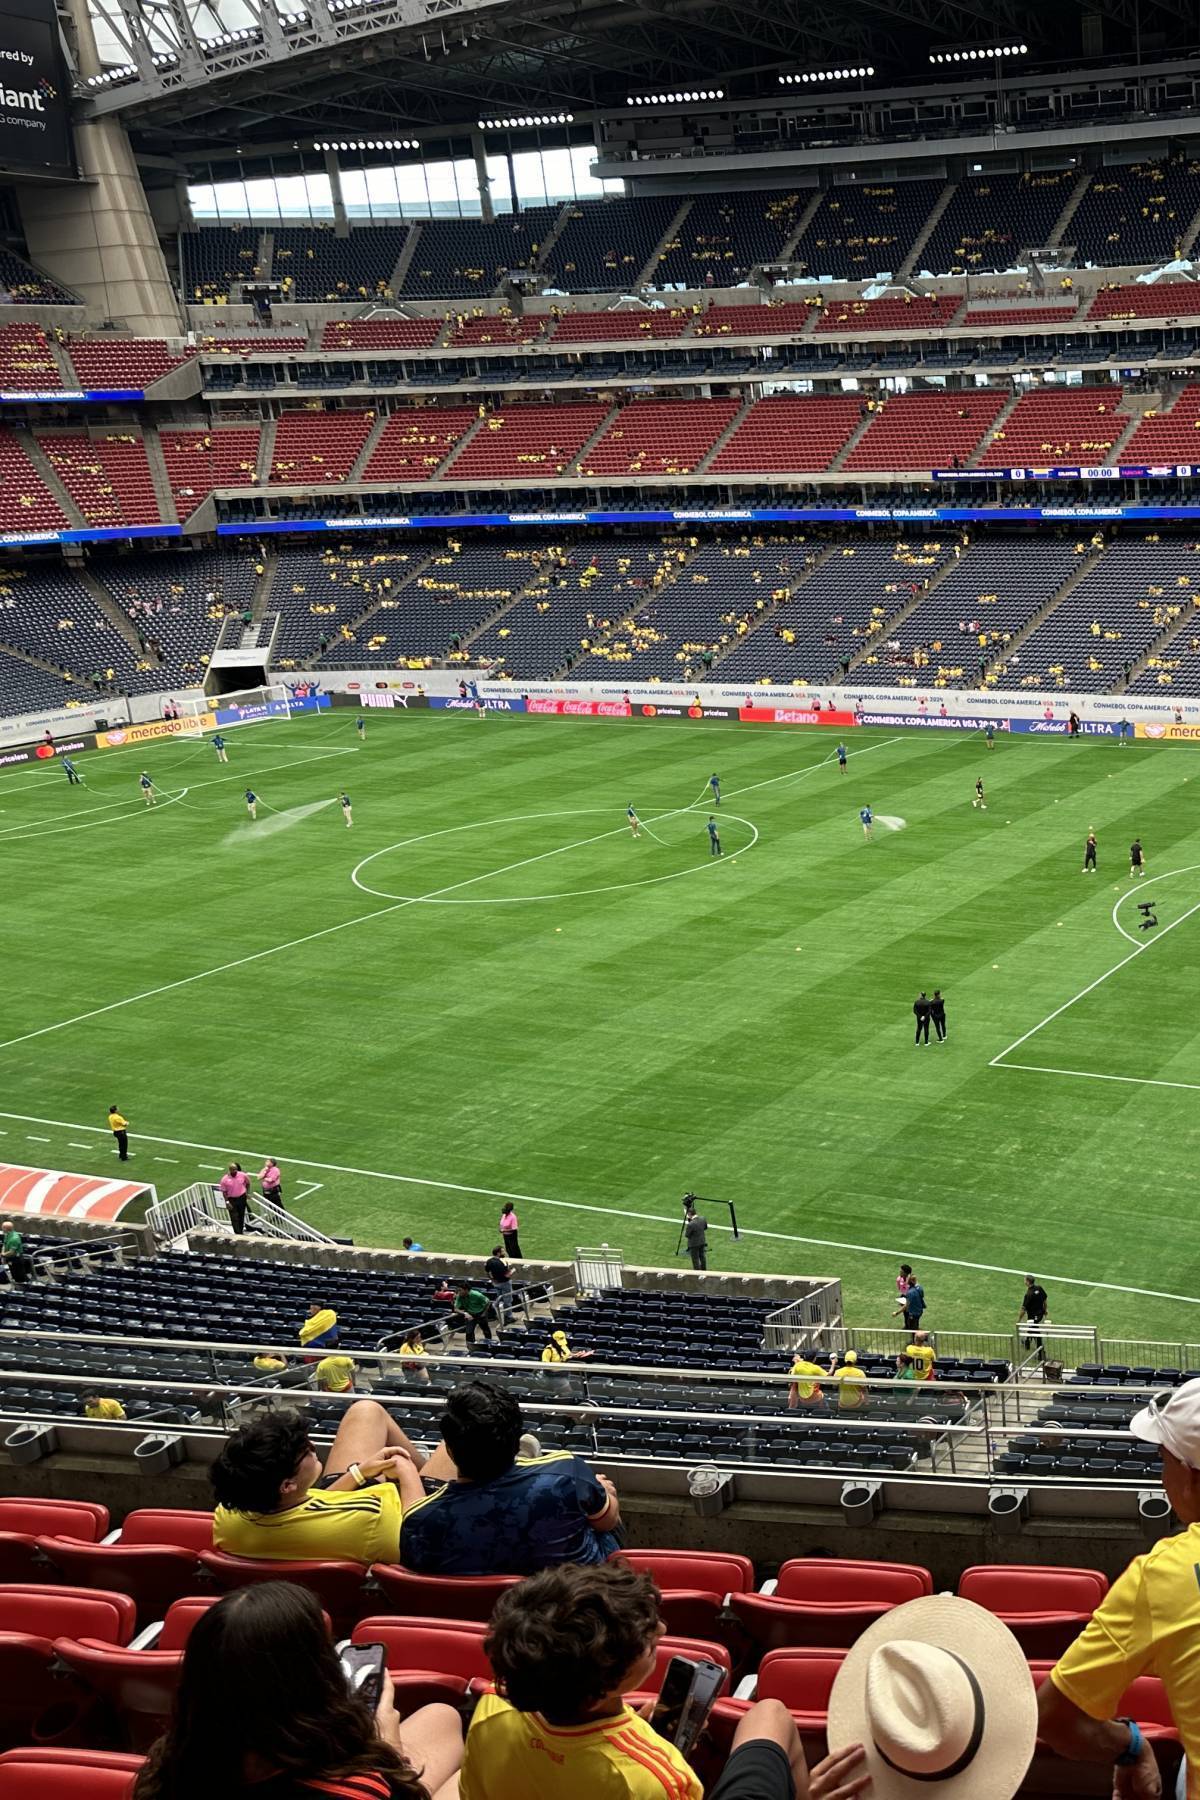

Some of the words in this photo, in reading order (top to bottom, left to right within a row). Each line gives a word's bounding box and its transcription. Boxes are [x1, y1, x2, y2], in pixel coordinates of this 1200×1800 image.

[21, 52, 34, 66] by
[6, 116, 46, 131] company
[281, 701, 305, 710] DLTA
[360, 694, 395, 708] PUMA
[704, 709, 729, 717] priceless
[775, 709, 819, 723] Betano
[863, 714, 905, 725] CONMEBOL
[906, 716, 926, 727] COPA
[926, 717, 962, 728] AMERICA
[962, 720, 978, 728] USA
[1029, 721, 1066, 733] Michelob
[131, 722, 182, 739] mercado
[56, 742, 85, 754] priceless
